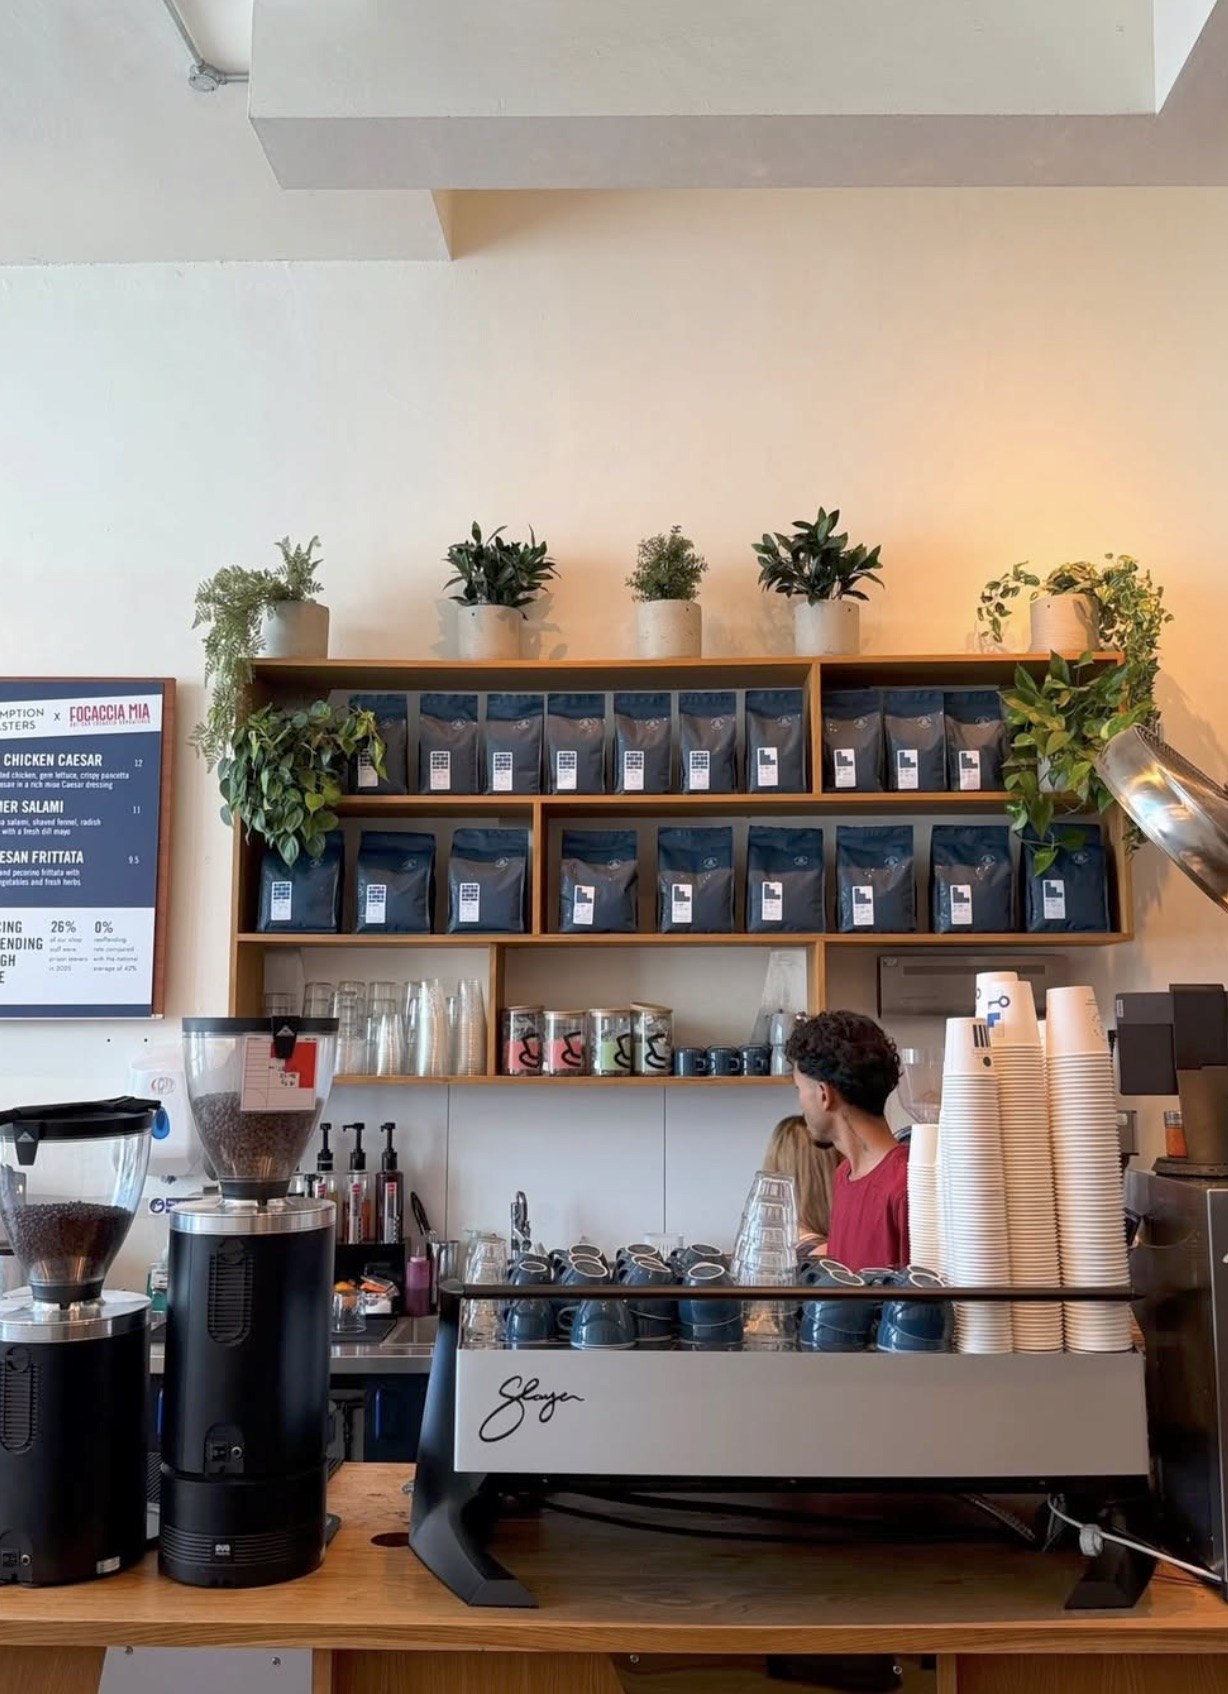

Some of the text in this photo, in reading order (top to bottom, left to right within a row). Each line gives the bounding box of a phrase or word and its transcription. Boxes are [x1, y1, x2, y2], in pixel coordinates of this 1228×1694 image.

[69, 704, 125, 722] FOCACCIA
[129, 703, 150, 720] MIA
[0, 720, 36, 731] STERS
[3, 753, 143, 767] CHICKEN CAESAR 12
[80, 771, 100, 781] crispy
[30, 780, 43, 789] rich
[61, 780, 84, 789] Caesar
[85, 780, 114, 790] dressing
[22, 799, 64, 813] SALAMI
[132, 806, 141, 814] 11
[7, 818, 31, 827] salami,
[32, 818, 55, 826] shaved
[80, 818, 102, 826] radish
[2, 827, 16, 835] with
[23, 827, 40, 835] fresh
[31, 850, 84, 864] FRITTATA
[12, 869, 40, 877] pecorino
[65, 868, 80, 876] with
[30, 878, 43, 886] and
[44, 878, 61, 886] fresh
[62, 878, 81, 886] herbs
[0, 920, 23, 934] ING
[51, 920, 77, 933] 26%
[94, 920, 114, 934] 0%
[0, 937, 44, 950] ENDING
